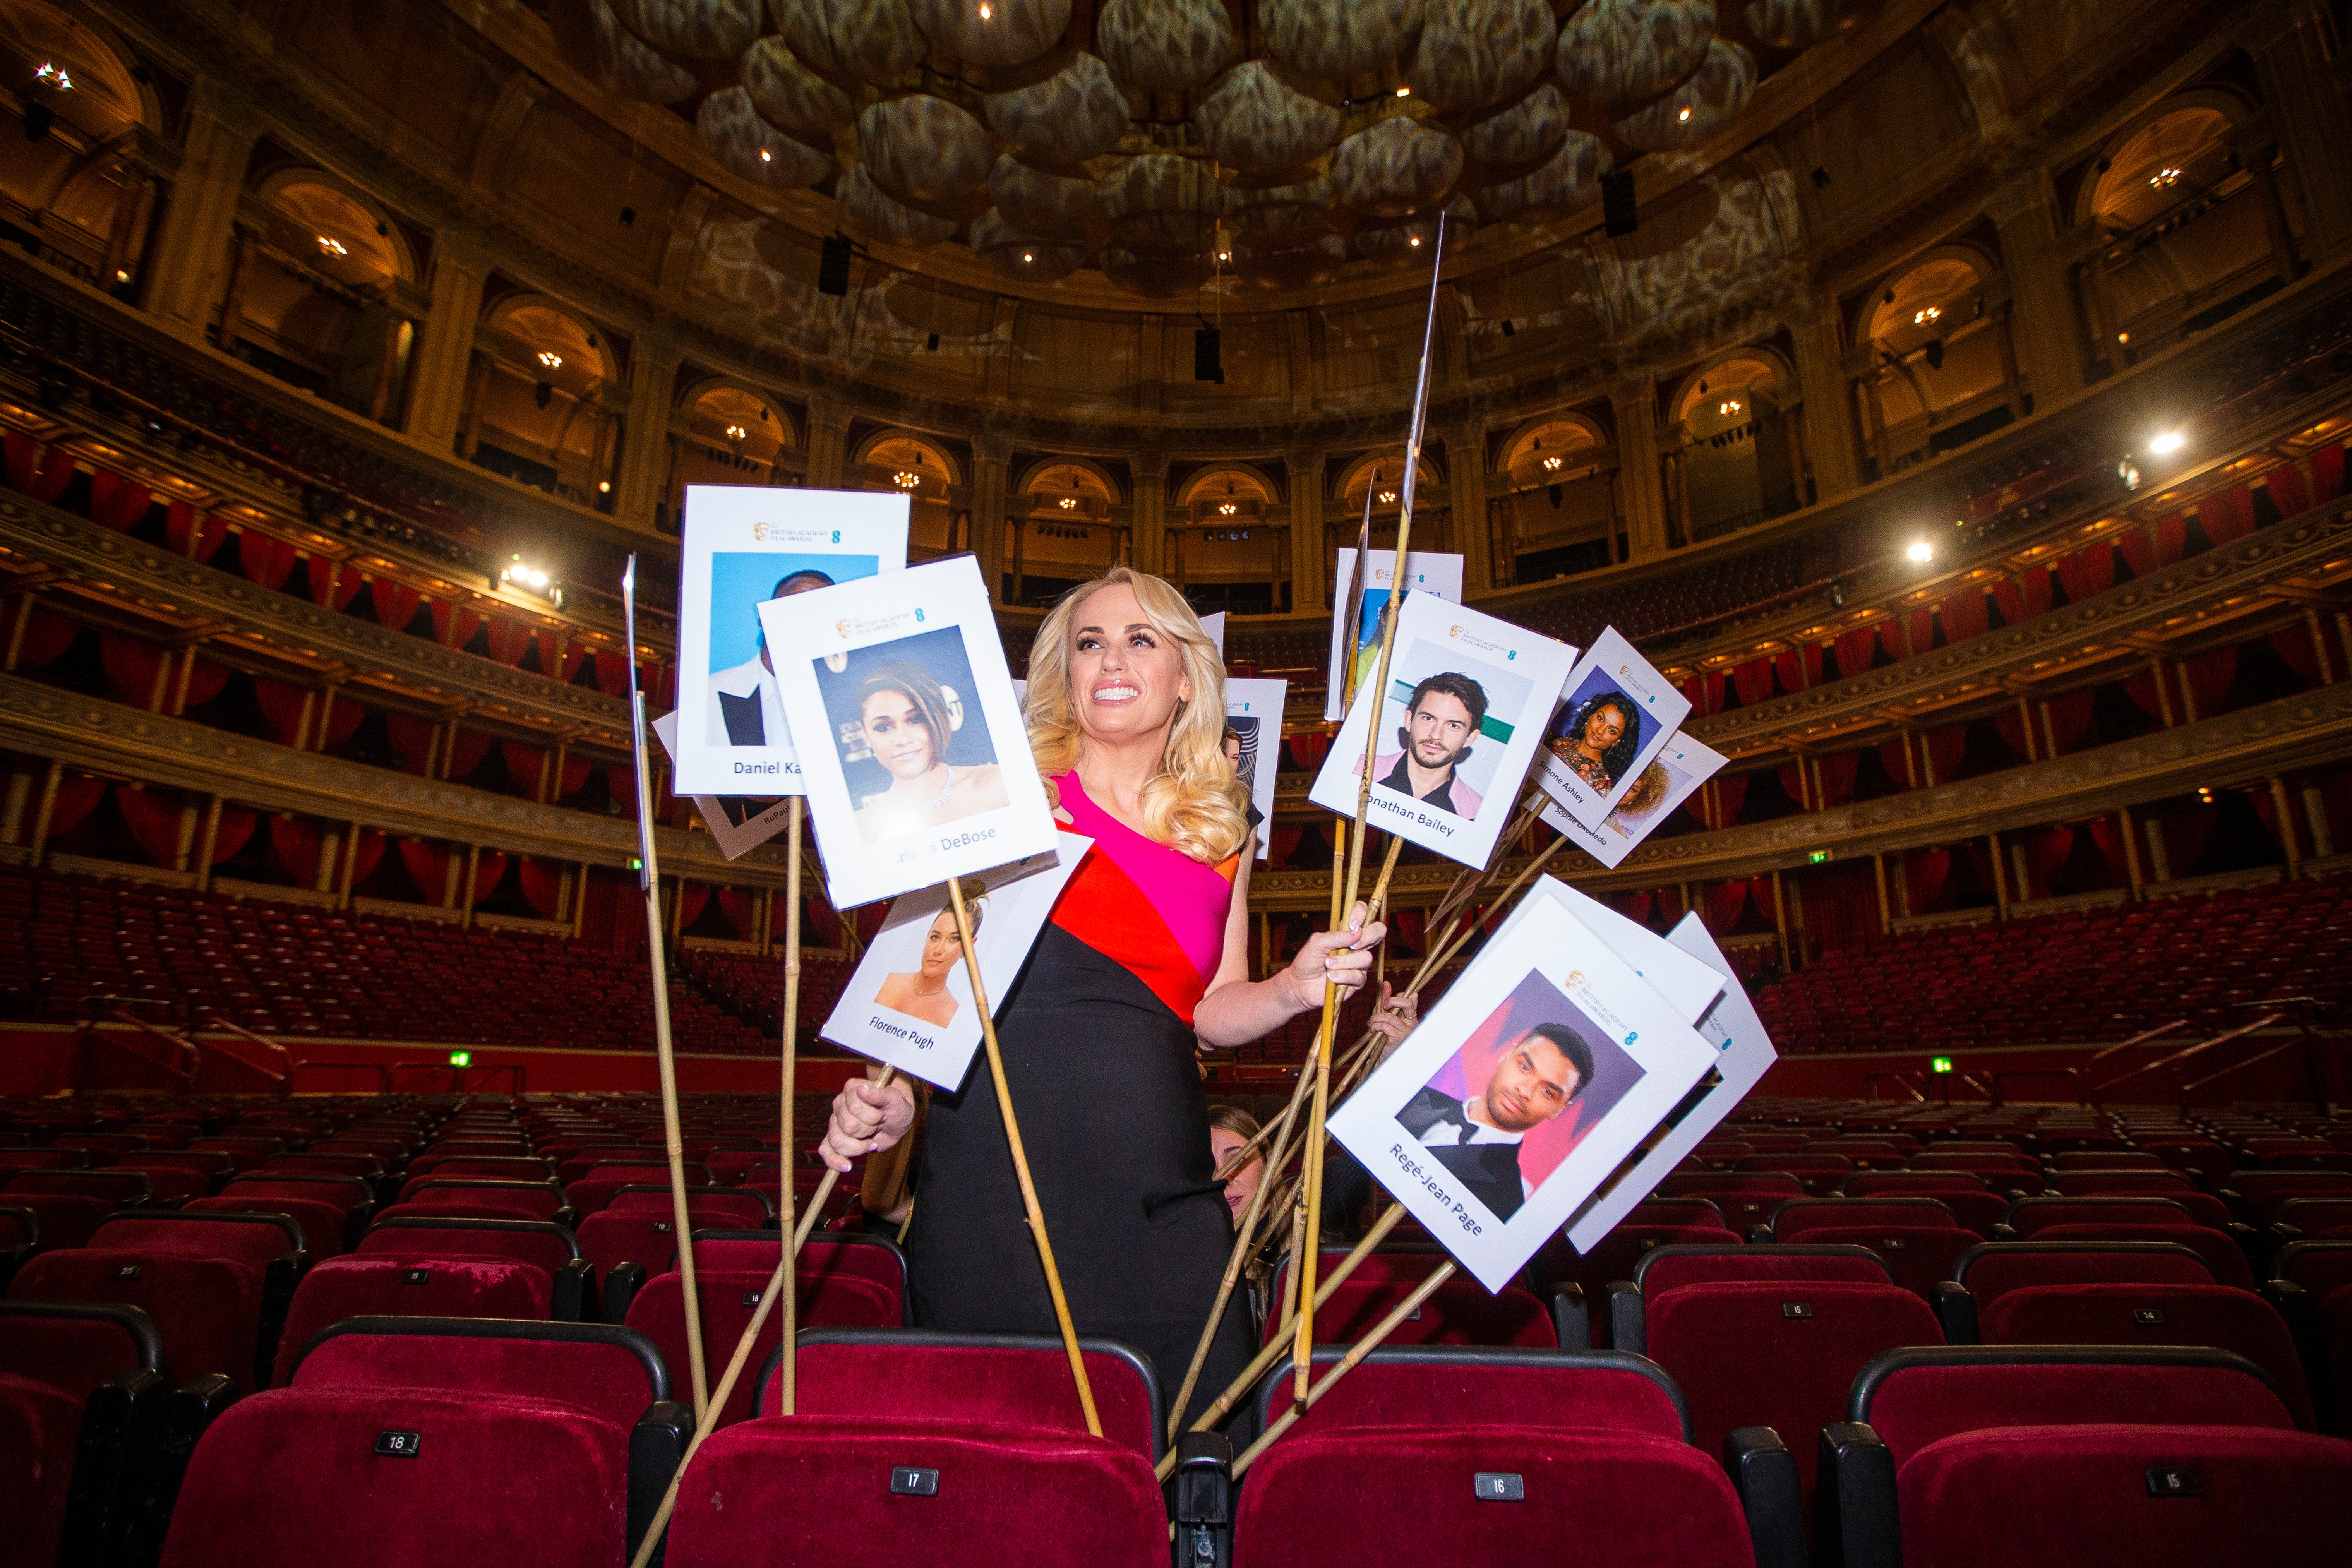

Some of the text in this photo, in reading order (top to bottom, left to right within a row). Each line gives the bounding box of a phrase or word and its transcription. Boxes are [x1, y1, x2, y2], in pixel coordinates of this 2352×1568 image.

[1463, 633, 1507, 652] BRITISH ACADEMY
[1473, 643, 1494, 652] AWARDS
[734, 761, 780, 774] Daniel
[1538, 760, 1584, 804] Simone Ashley
[1368, 795, 1455, 837] onathan Bailey
[1555, 807, 1577, 824] Sophie
[941, 828, 996, 851] DeBose
[1577, 992, 1612, 1025] FILM AWARDS
[1582, 987, 1629, 1032] BRITISH ACADEMY
[869, 1016, 934, 1050] Florence Pugh
[1390, 1143, 1482, 1236] Regé-Jean Page
[390, 1436, 405, 1449] 18
[909, 1472, 919, 1487] 17
[1494, 1479, 1505, 1493] 16
[2167, 1472, 2180, 1488] 15
